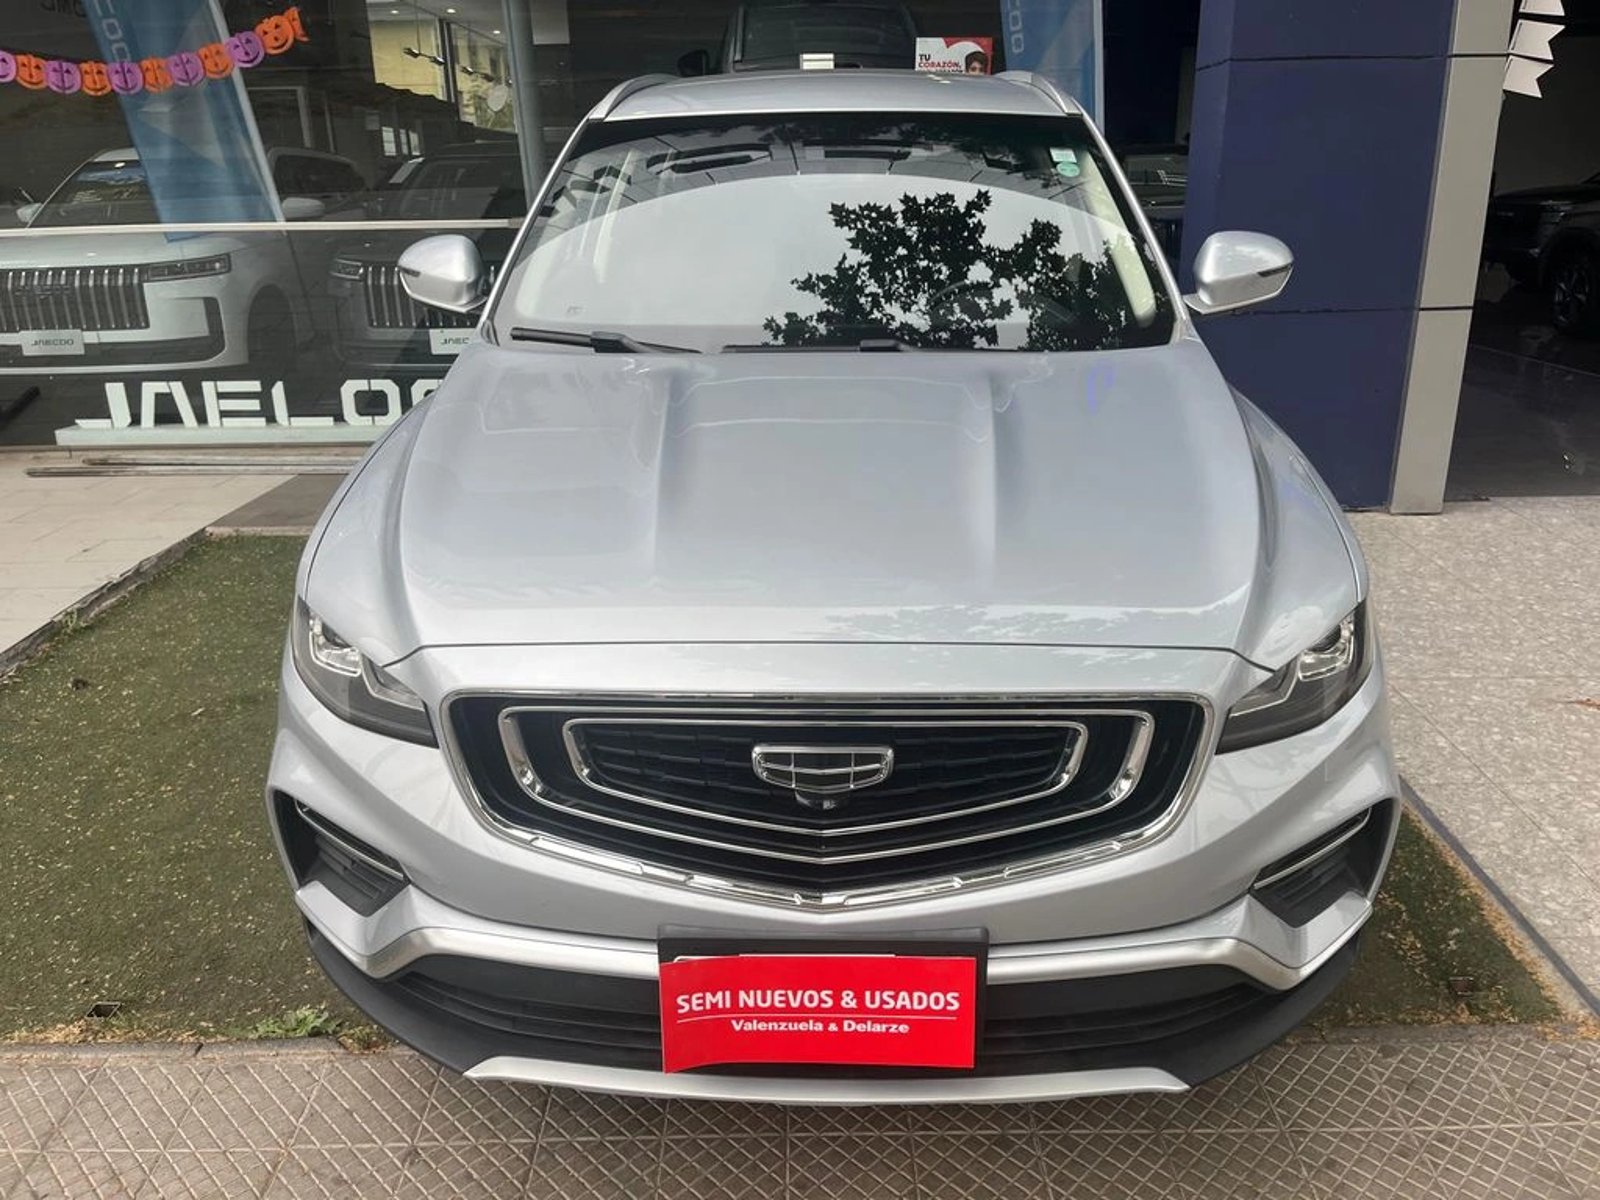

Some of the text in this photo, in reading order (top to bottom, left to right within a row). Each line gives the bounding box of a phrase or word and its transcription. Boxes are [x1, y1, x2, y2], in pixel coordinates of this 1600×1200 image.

[676, 989, 960, 1014] SEMI NUEVOS & USADOS
[731, 1019, 910, 1034] Valenzuela & Delarze
